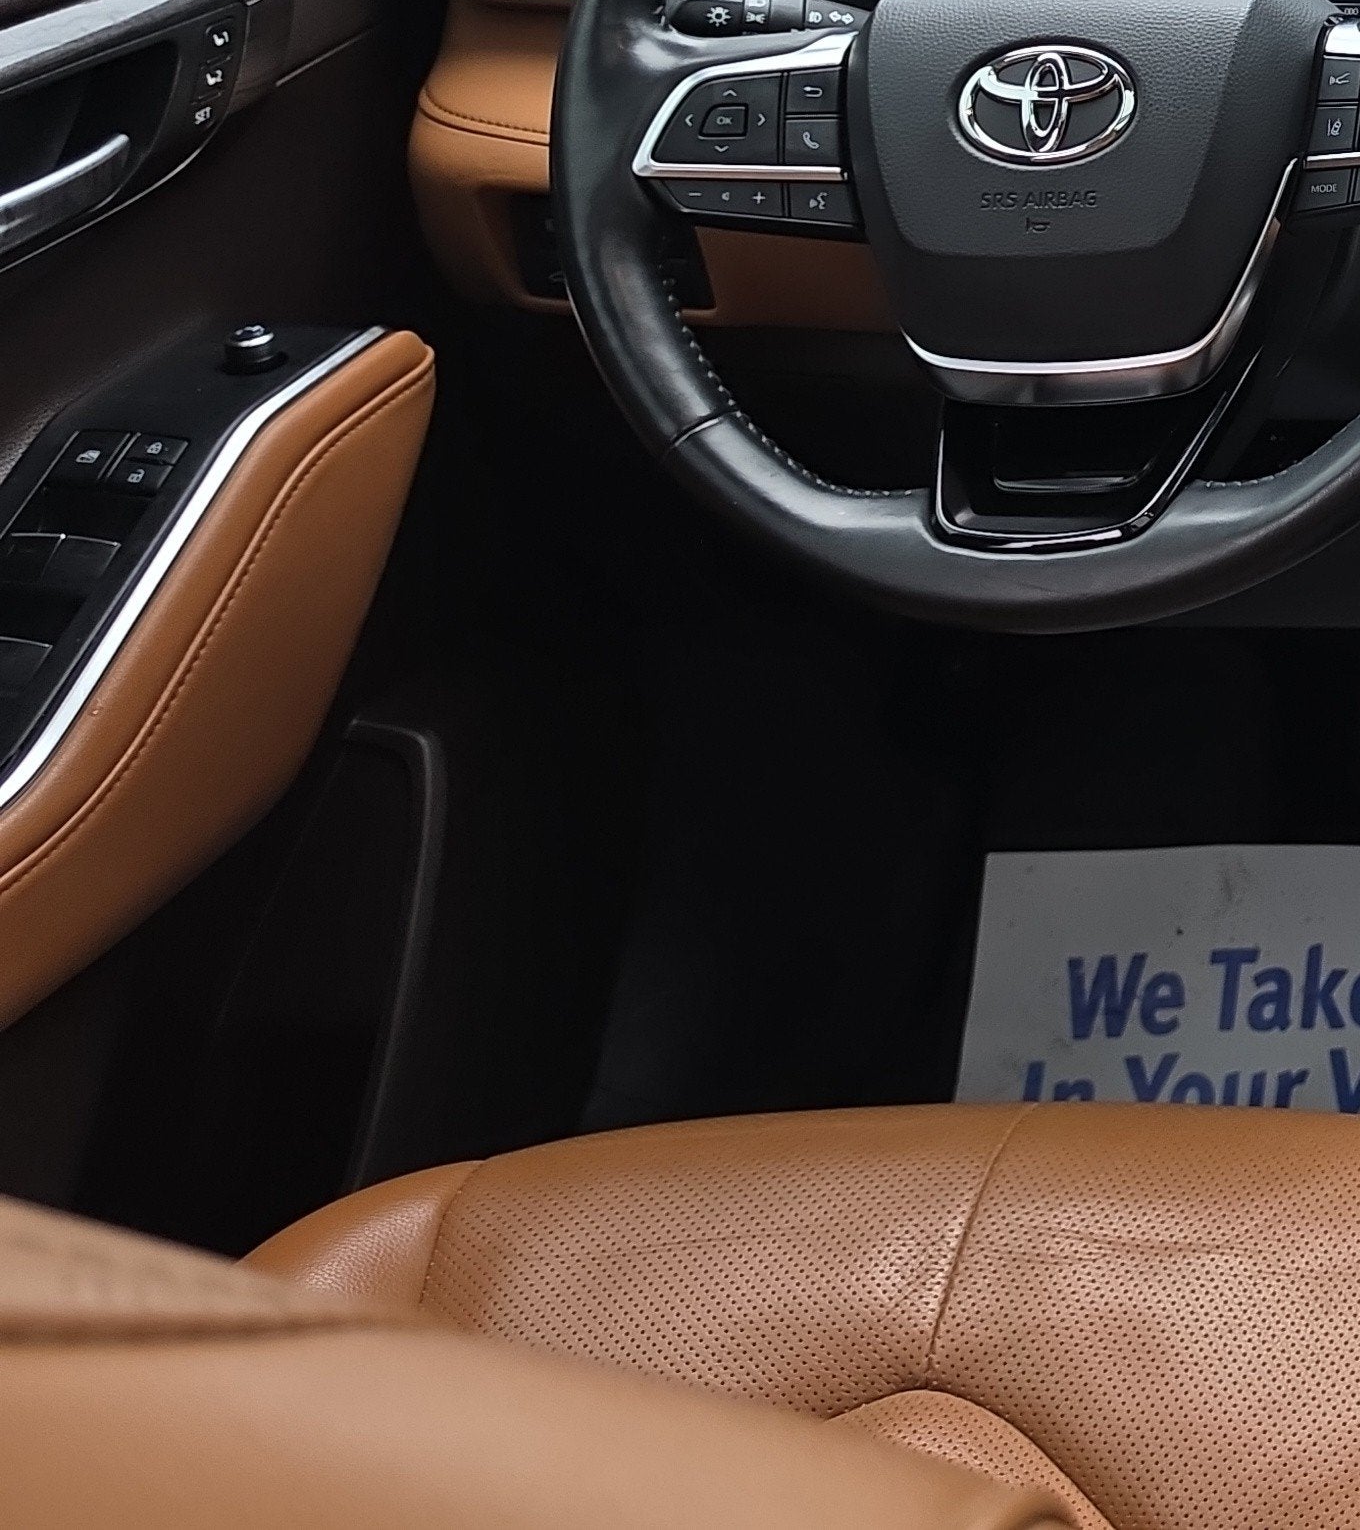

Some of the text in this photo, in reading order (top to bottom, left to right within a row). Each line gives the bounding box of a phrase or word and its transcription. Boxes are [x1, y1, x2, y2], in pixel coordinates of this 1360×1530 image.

[717, 116, 733, 125] OK
[1311, 182, 1338, 193] MODE
[980, 190, 1098, 209] SRS AIRBAG
[1067, 951, 1186, 1041] We
